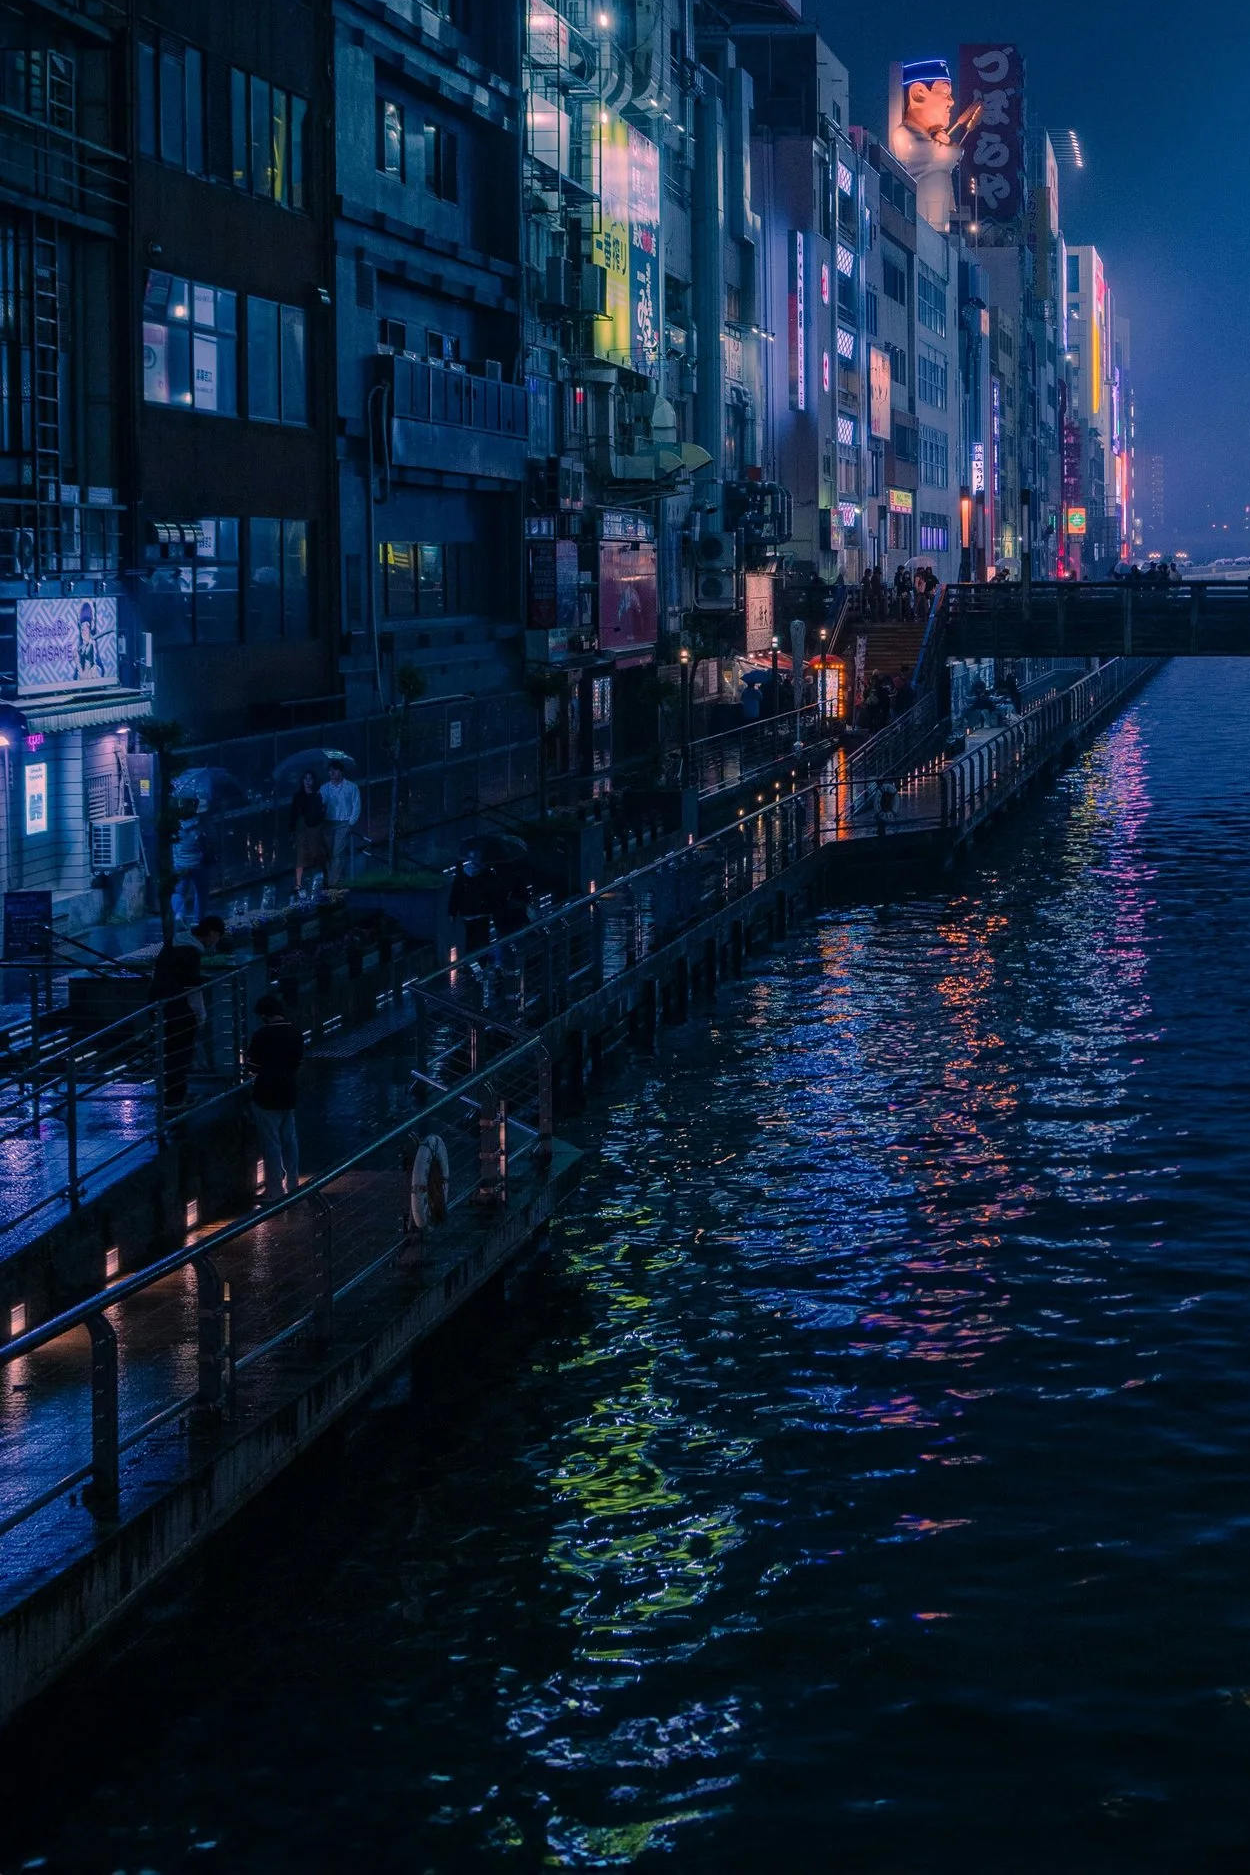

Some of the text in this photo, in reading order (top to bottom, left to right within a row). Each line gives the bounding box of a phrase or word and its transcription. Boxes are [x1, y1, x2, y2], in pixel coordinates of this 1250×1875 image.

[972, 46, 1016, 210] づぼらや
[21, 643, 73, 665] MURASAME
